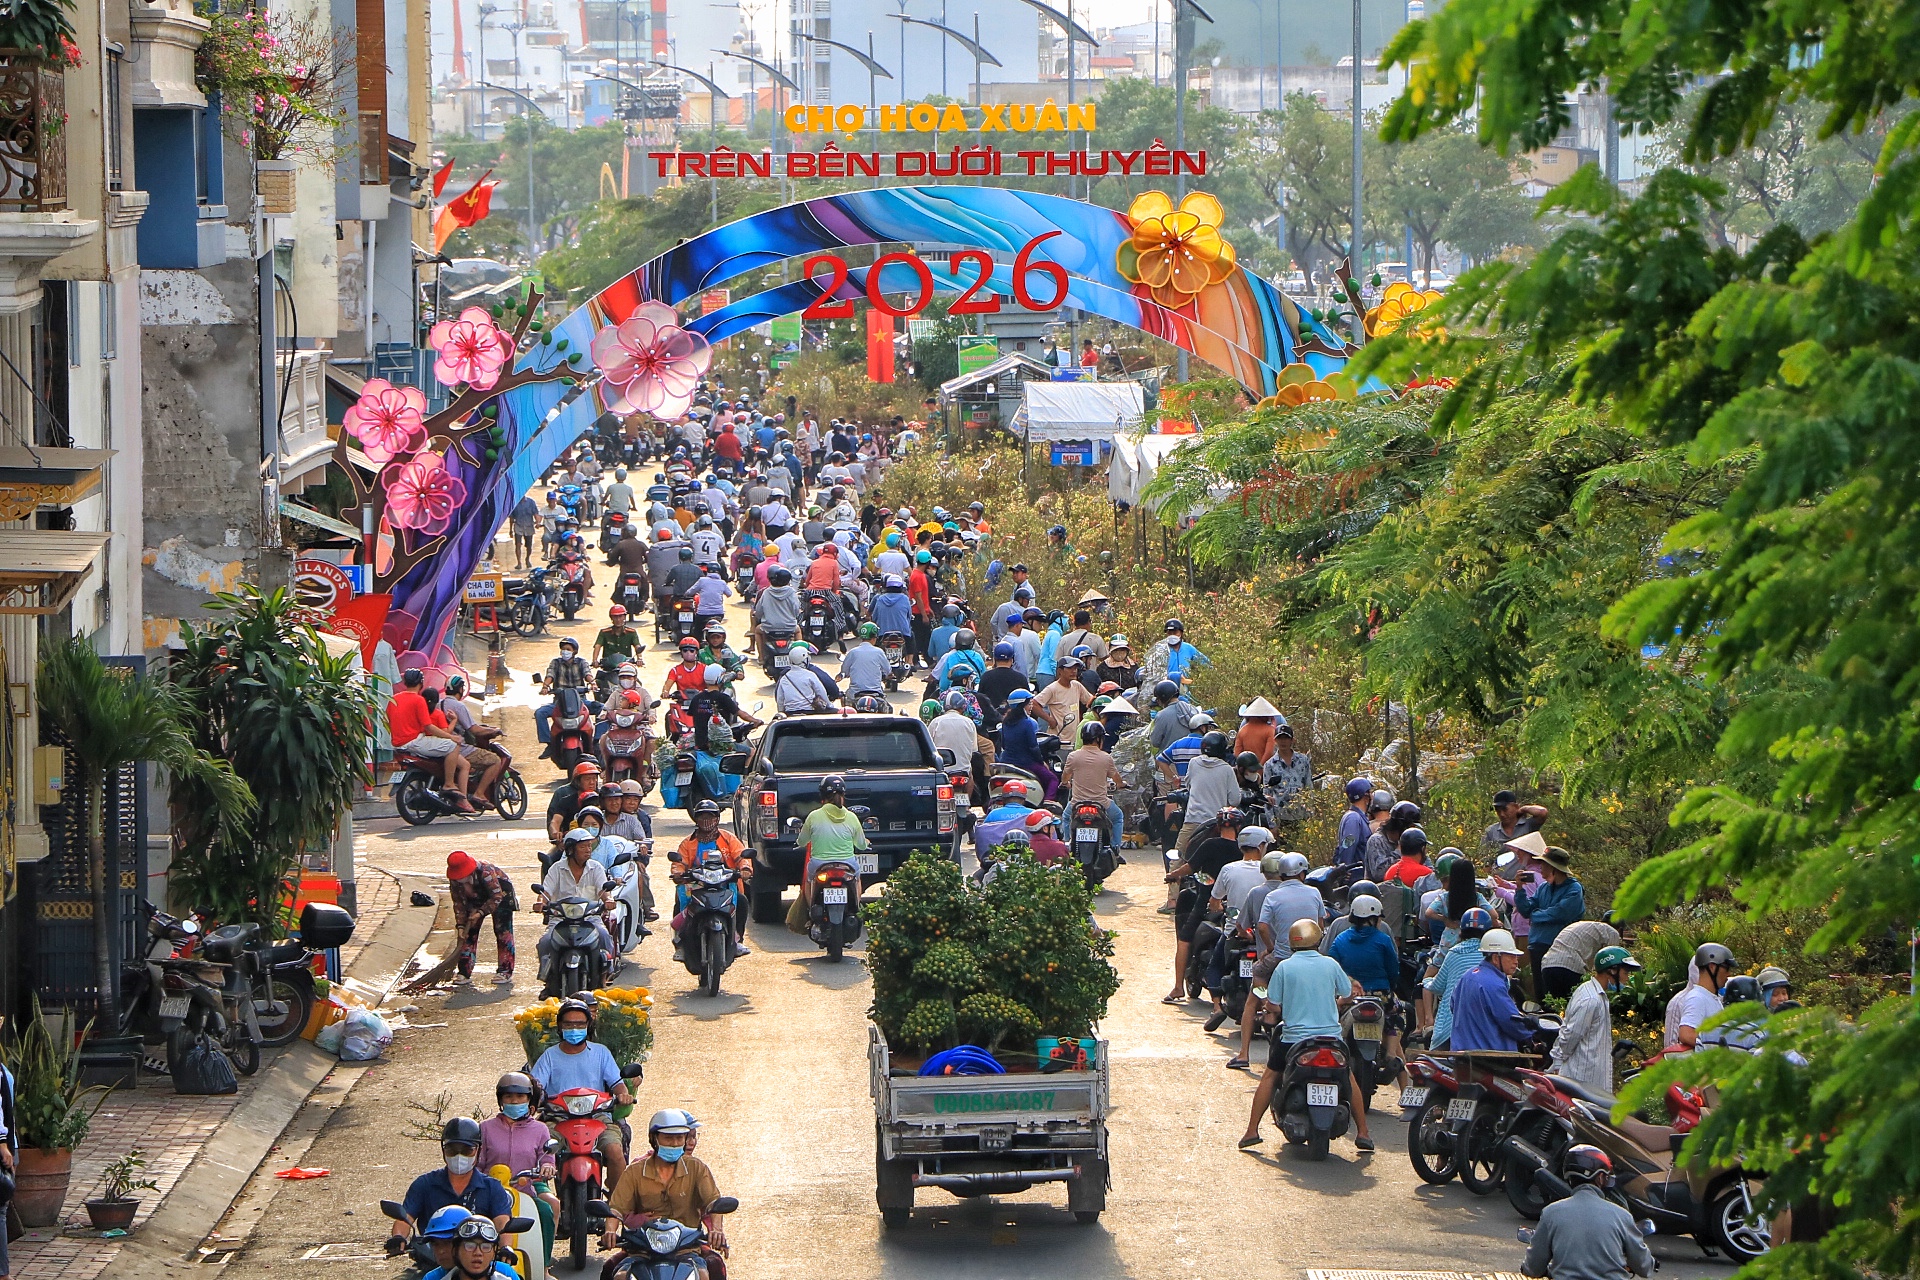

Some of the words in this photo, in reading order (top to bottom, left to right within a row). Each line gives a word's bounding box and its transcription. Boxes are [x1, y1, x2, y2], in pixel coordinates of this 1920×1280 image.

[784, 104, 867, 141] CHỢ
[880, 103, 968, 133] HOA
[979, 97, 1097, 133] XUÂN
[648, 145, 771, 178] TRÊN
[786, 141, 880, 178] BẾN
[895, 144, 1002, 177] DƯỚI
[1017, 137, 1206, 177] THUYỀN
[803, 231, 1068, 320] 2026
[701, 540, 710, 555] 4
[333, 620, 369, 640] IGHLANDS
[857, 856, 868, 864] 1H
[1599, 954, 1615, 965] Grab
[1311, 1085, 1335, 1095] 51-L7
[933, 1092, 1056, 1114] 0908845287
[1311, 1095, 1335, 1105] 5976
[1448, 1109, 1470, 1119] 3321
